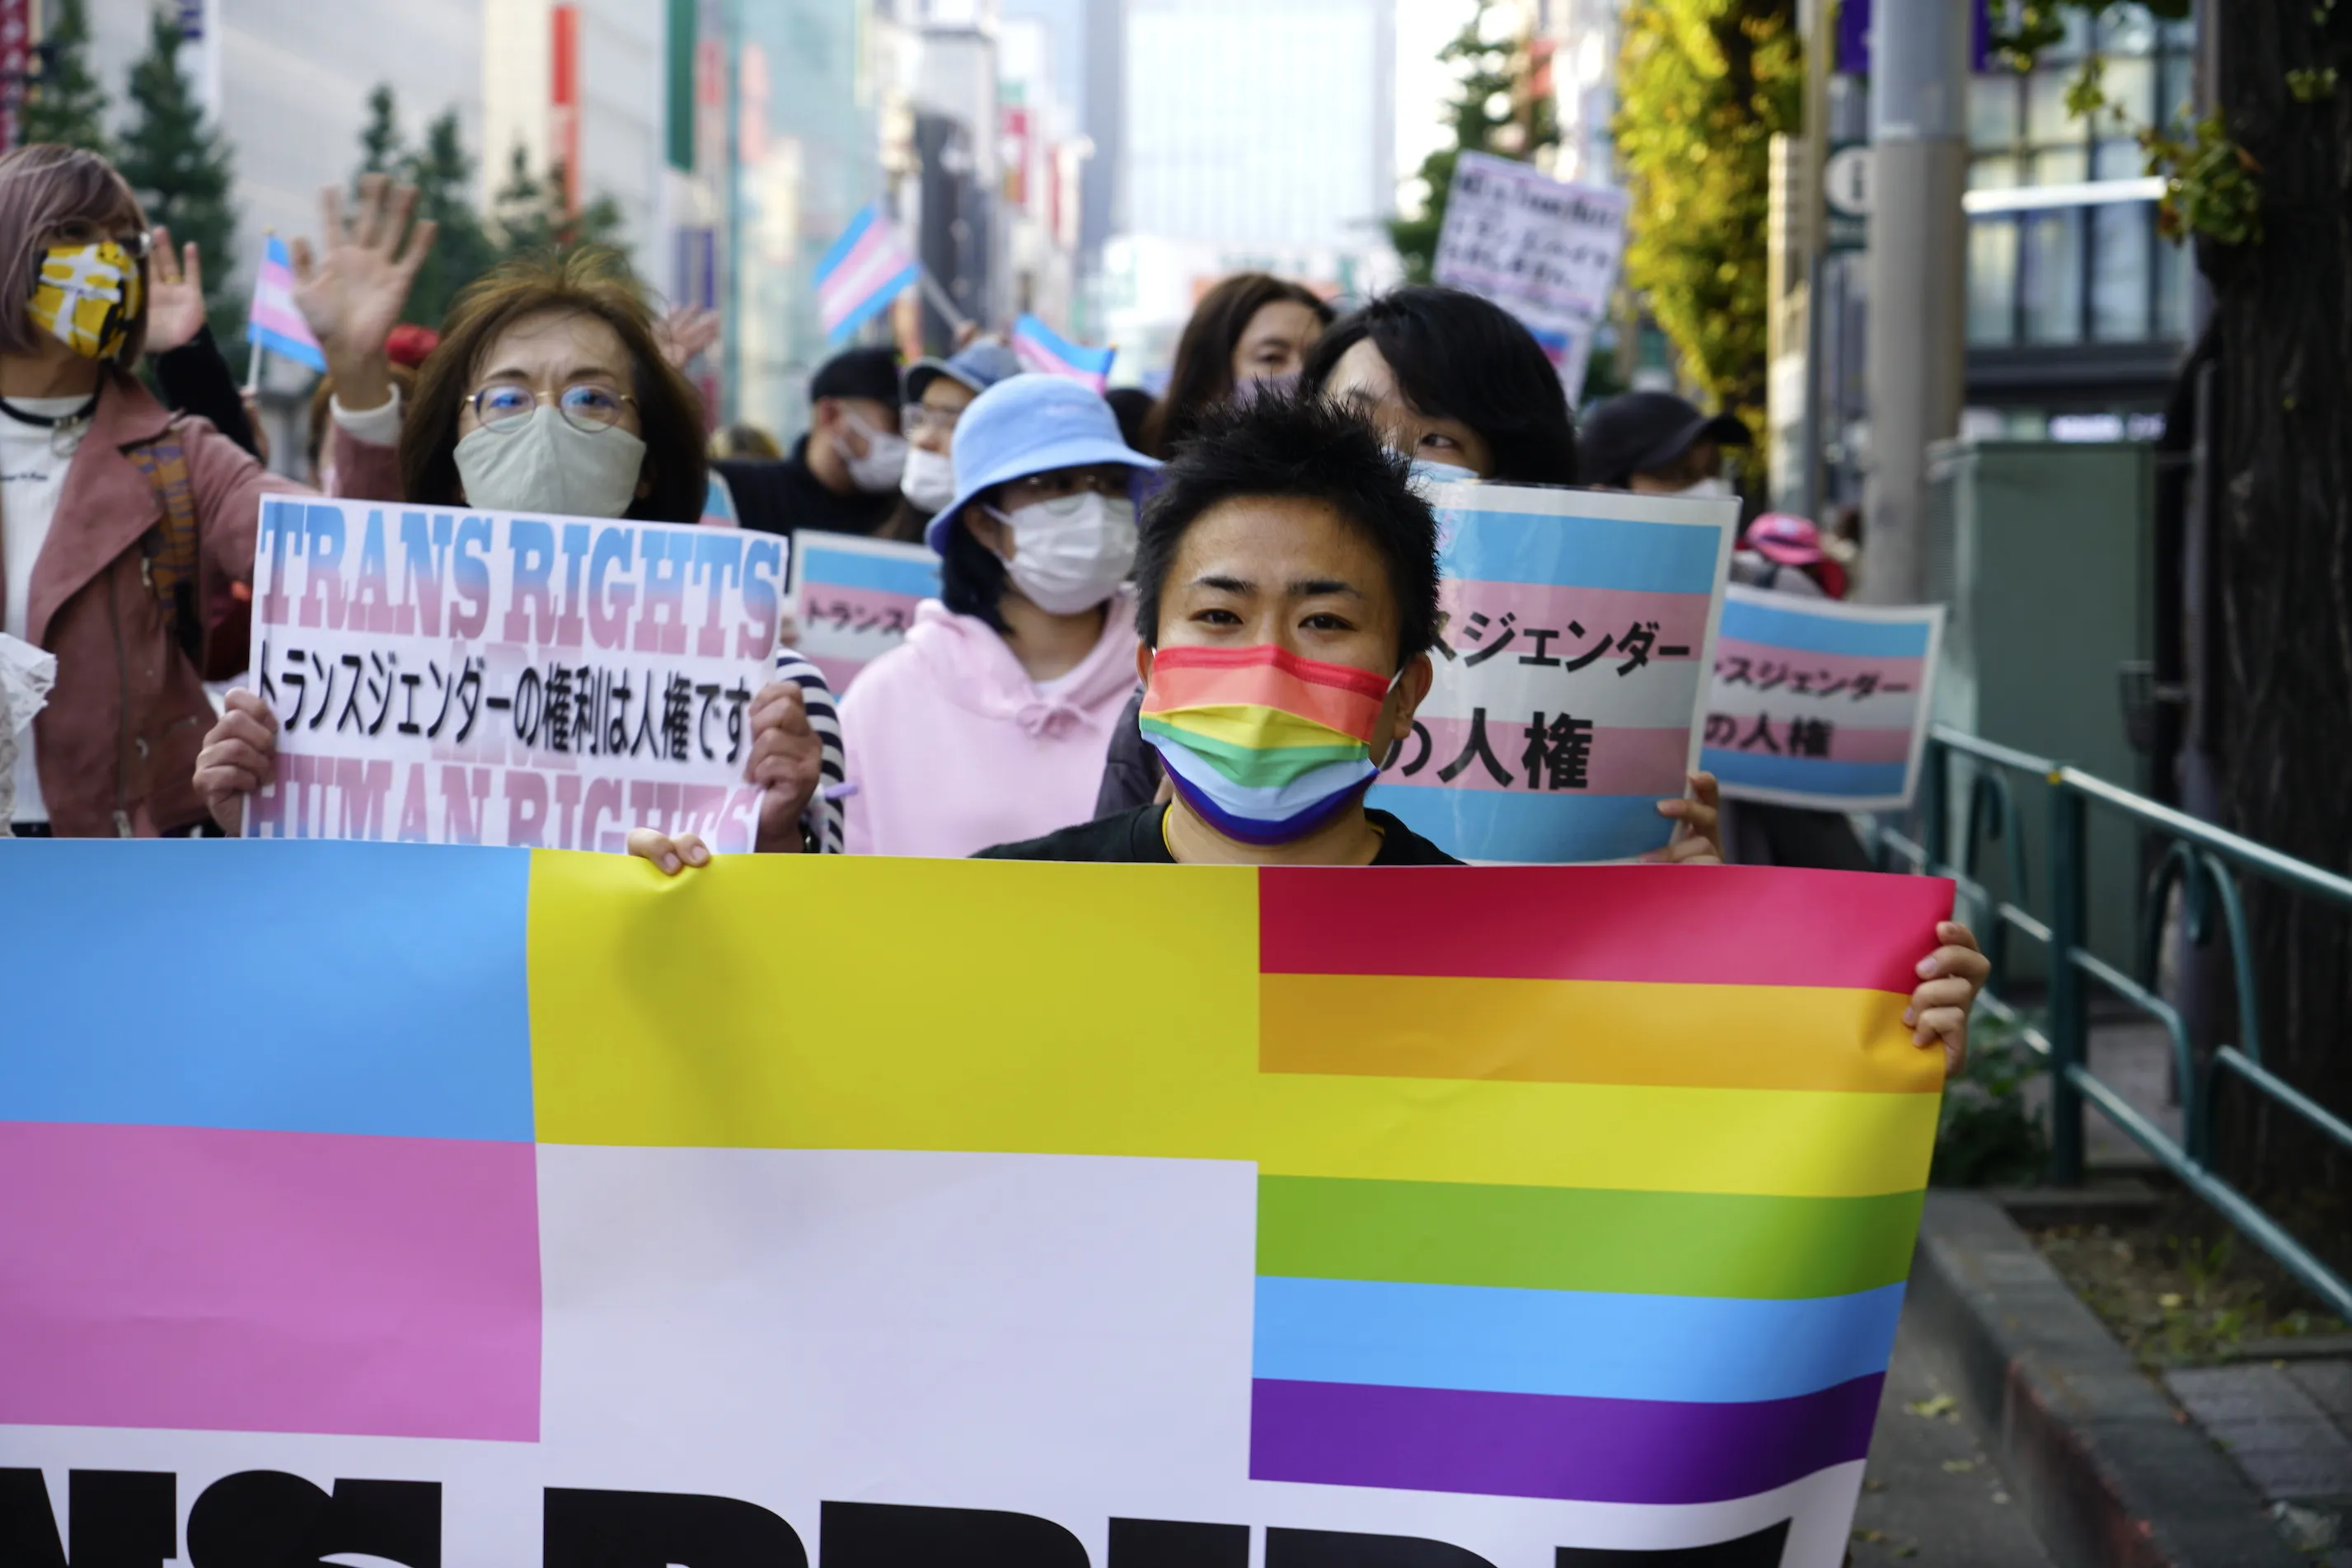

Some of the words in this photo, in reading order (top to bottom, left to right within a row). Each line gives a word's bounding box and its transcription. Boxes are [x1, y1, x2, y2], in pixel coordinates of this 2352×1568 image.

[260, 500, 493, 639] TRANS
[503, 519, 780, 661] RIGHTS
[260, 639, 752, 764] トランスジェンダーの権利は人権です
[1704, 711, 1834, 760] の人権
